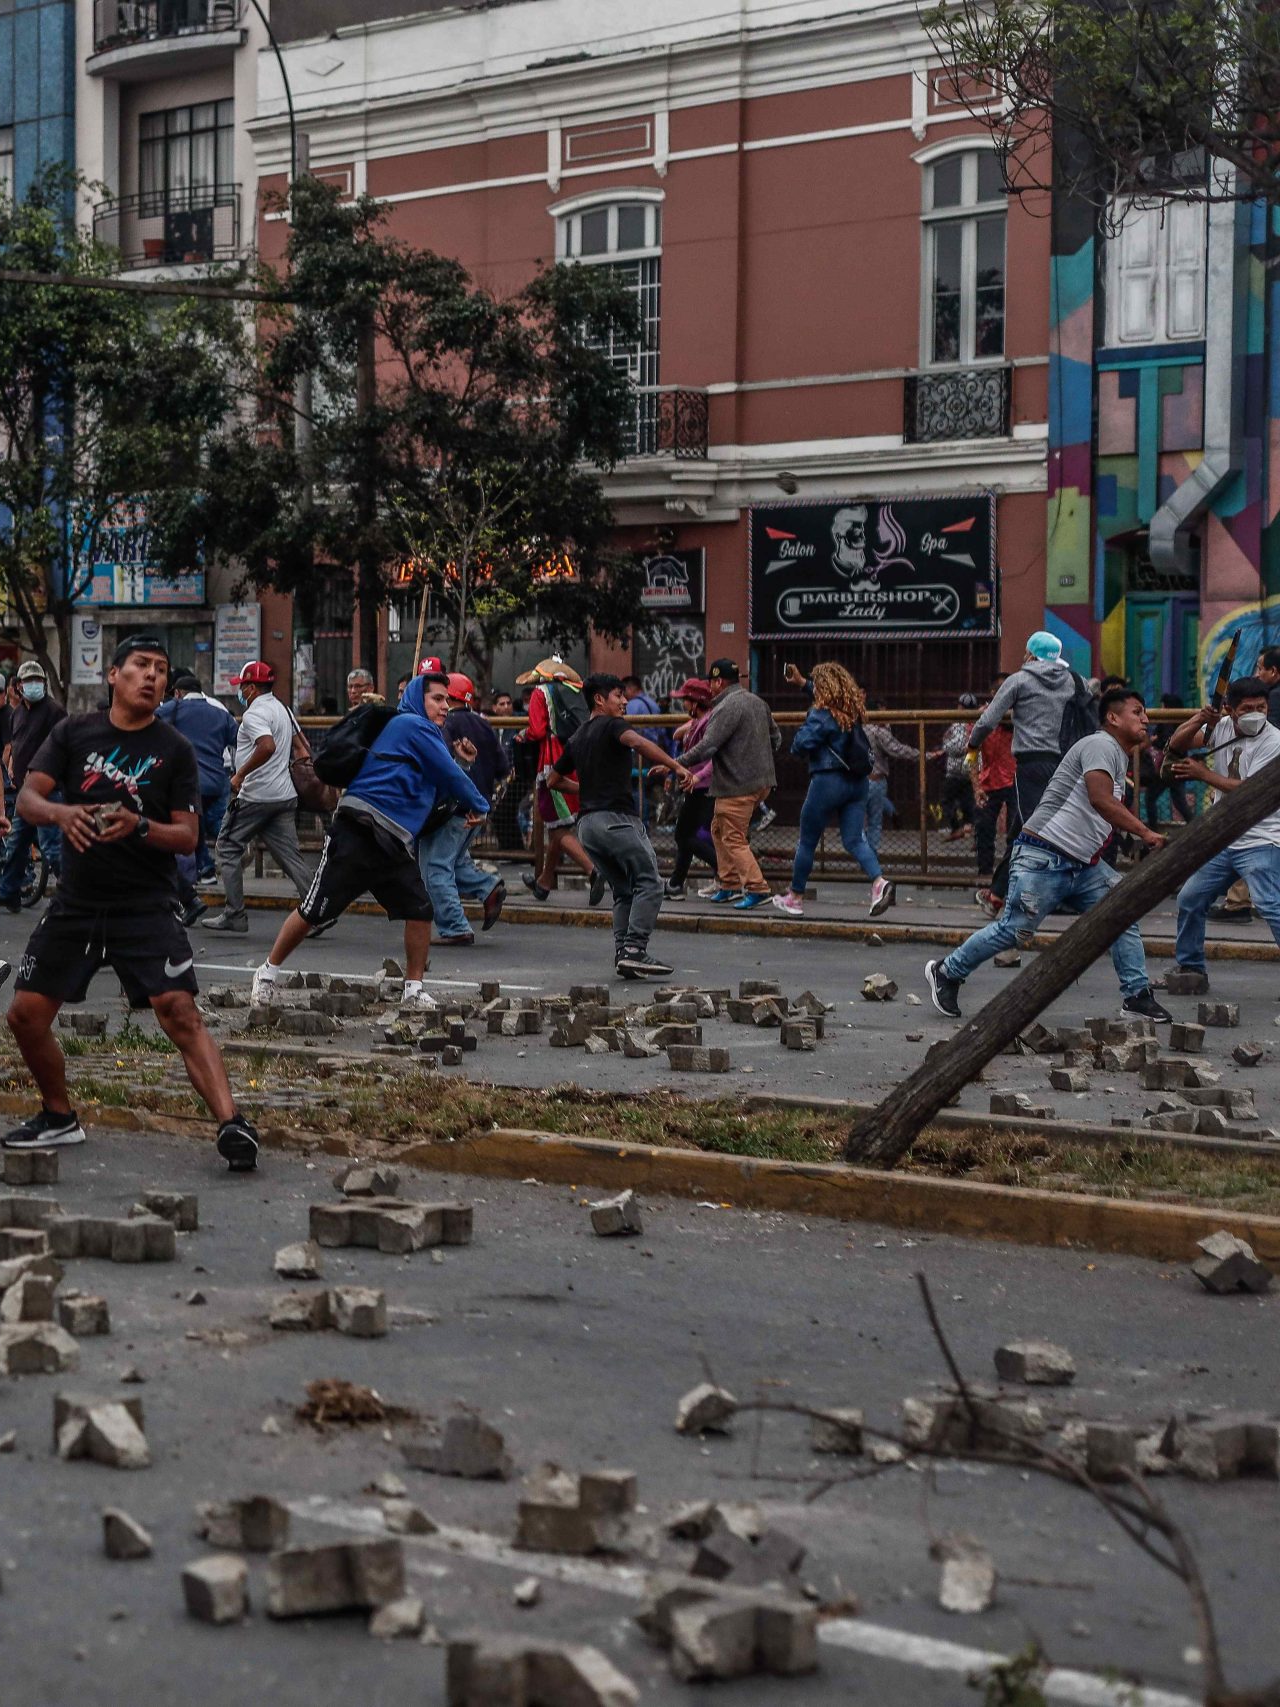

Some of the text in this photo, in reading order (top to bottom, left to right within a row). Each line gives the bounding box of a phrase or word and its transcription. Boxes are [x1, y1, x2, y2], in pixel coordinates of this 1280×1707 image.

[779, 540, 816, 559] Salon
[921, 532, 948, 556] Spa
[802, 590, 931, 604] BARBERSHOP
[838, 603, 887, 620] Lady
